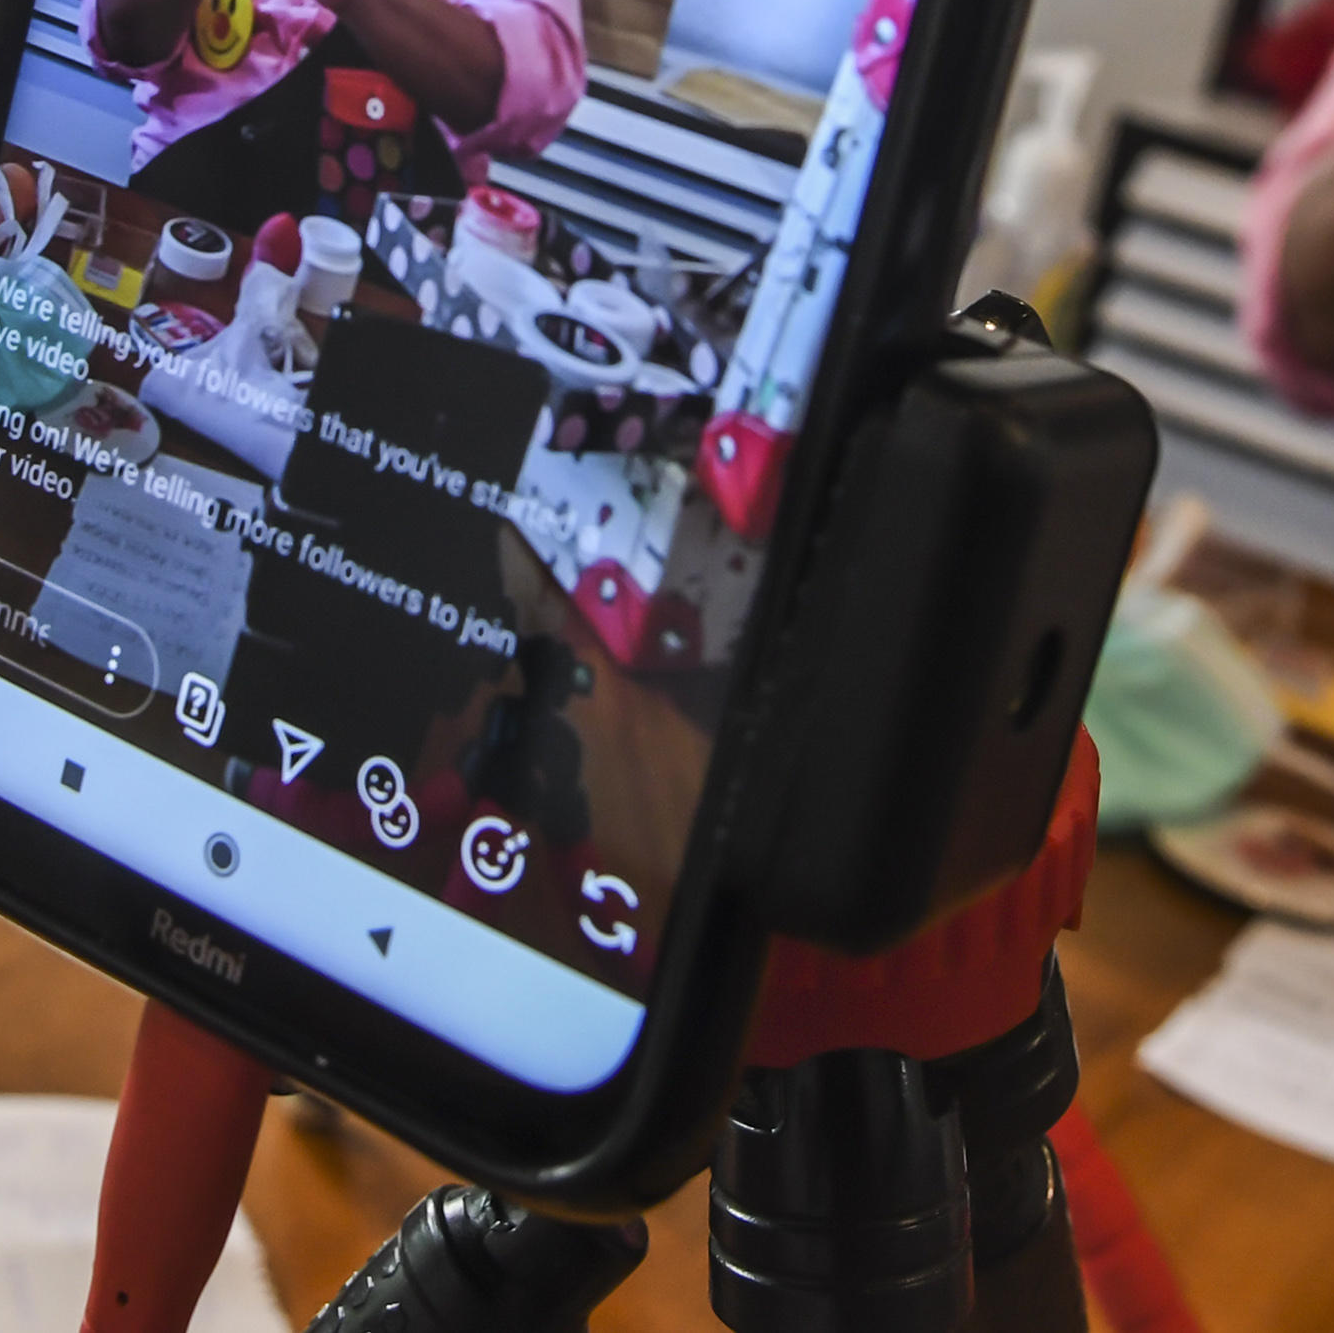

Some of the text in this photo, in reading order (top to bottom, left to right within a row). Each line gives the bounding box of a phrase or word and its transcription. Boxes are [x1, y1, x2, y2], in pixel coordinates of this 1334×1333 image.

[26, 335, 94, 385] video.
[59, 303, 132, 361] telling
[133, 339, 193, 378] your
[195, 358, 315, 433] followers
[319, 411, 374, 459] that
[374, 442, 467, 498] you've
[11, 453, 77, 503] video.
[30, 420, 70, 453] on!
[74, 432, 140, 486] We're
[143, 466, 220, 529] telling
[224, 508, 294, 556] more
[298, 533, 425, 616] followers
[428, 593, 459, 632] to
[457, 607, 518, 658] join
[150, 907, 248, 985] Redmi
